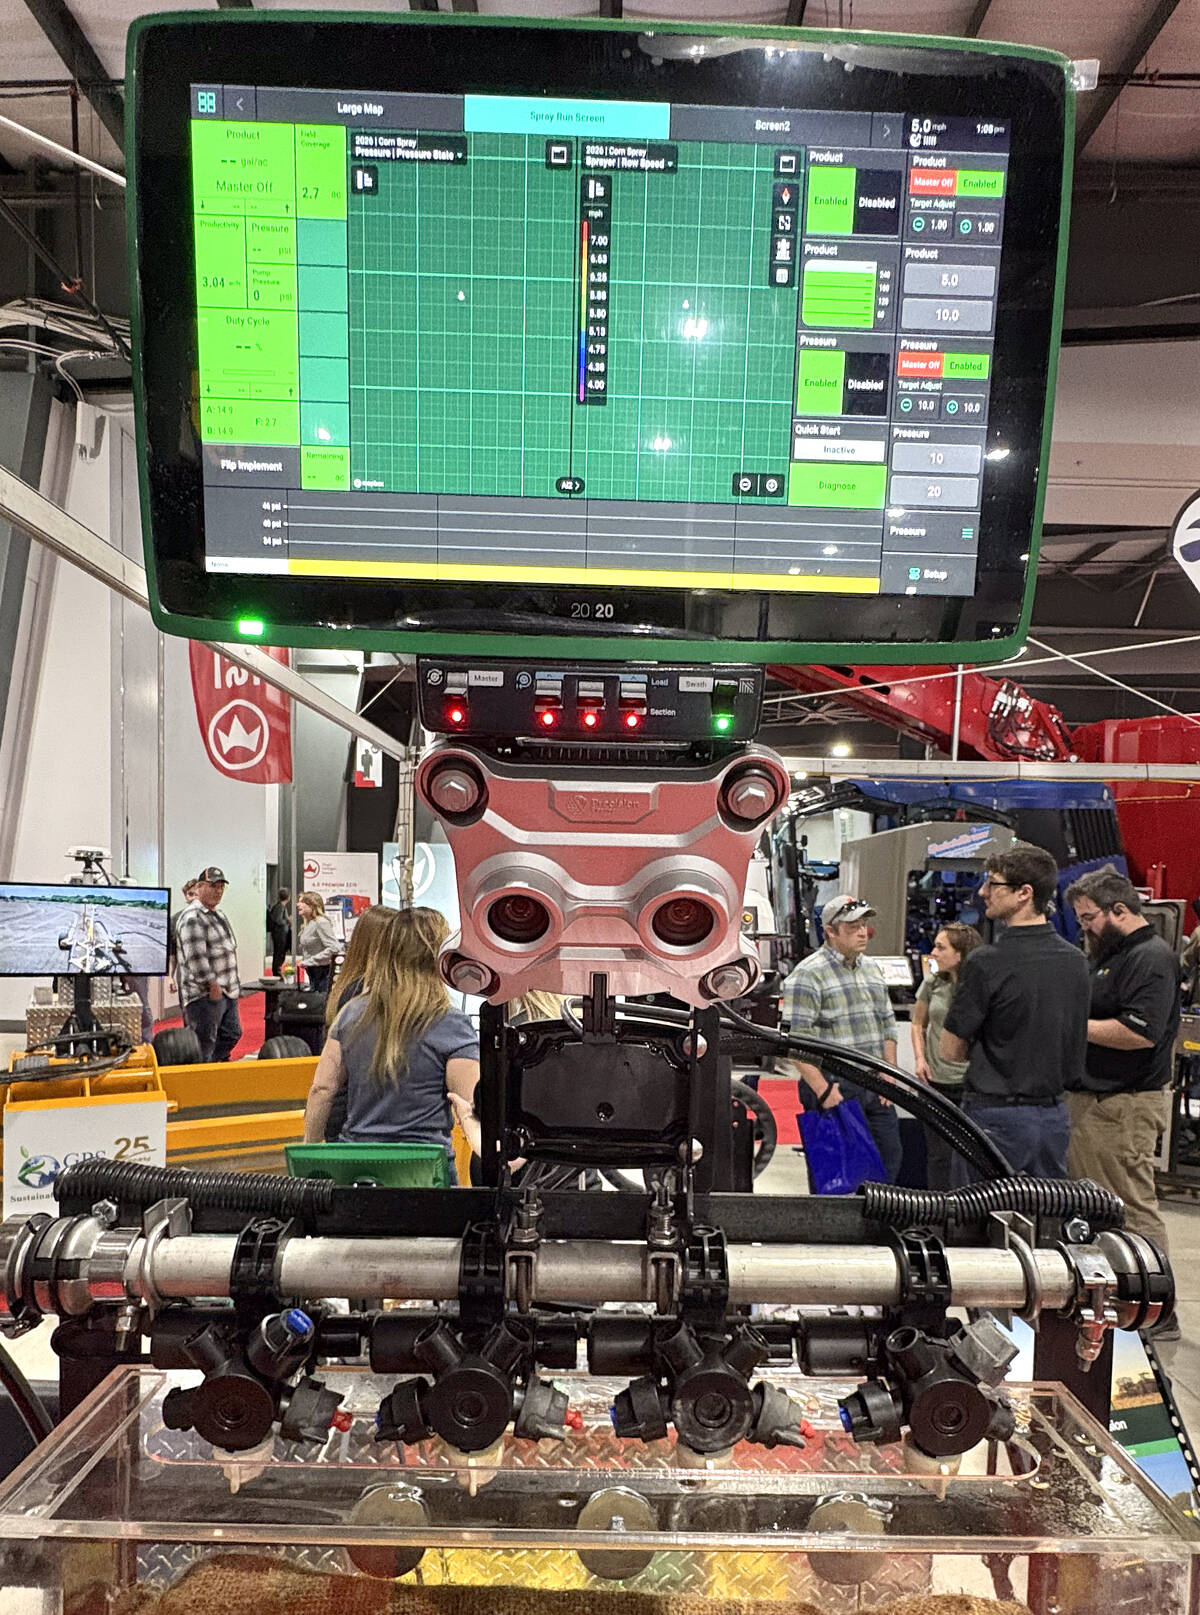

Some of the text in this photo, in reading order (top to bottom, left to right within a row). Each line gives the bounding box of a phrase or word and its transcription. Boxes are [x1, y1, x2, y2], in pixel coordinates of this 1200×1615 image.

[337, 102, 383, 116] Large Map
[530, 111, 605, 123] Spray Run Screen
[755, 119, 791, 132] Screen2
[932, 123, 947, 132] mph
[226, 129, 260, 140] Product
[301, 130, 316, 138] Field
[301, 141, 330, 150] Coverage
[378, 136, 396, 146] Corn
[396, 137, 416, 149] Spray
[355, 146, 454, 161] Pressure Pressure State
[609, 147, 626, 156] Corn
[626, 147, 647, 158] Spray
[809, 151, 843, 163] Product
[240, 157, 268, 168] gal/ac
[585, 156, 665, 171] Sprayer Row Speed
[912, 156, 946, 167] Product
[216, 180, 273, 193] Master Off
[914, 178, 953, 187] Master Off
[964, 179, 997, 189] Enabled
[302, 187, 319, 200] 2.7
[814, 196, 848, 206] Enabled
[858, 197, 896, 209] Disabled
[910, 198, 956, 210] Target Adjust
[588, 210, 603, 219] mph
[200, 220, 239, 230] Productivity
[251, 223, 289, 233] Pressure
[931, 219, 947, 230] 1.00
[977, 222, 995, 232] 1.00
[591, 235, 608, 246] 7.00
[804, 245, 838, 256] Product
[905, 248, 938, 259] Product
[202, 276, 224, 288] 3.04
[253, 289, 260, 301] 0
[936, 308, 959, 321] 10.0
[225, 315, 270, 327] Duty Cycle
[800, 336, 837, 347] Pressure
[901, 340, 938, 351] Pressure
[902, 360, 940, 370] Master Off
[950, 361, 983, 371] Enabled
[587, 380, 605, 390] 4.00
[804, 378, 837, 388] Enabled
[847, 379, 884, 391] Disabled
[898, 381, 942, 392] Target Adjust
[918, 400, 935, 411] 10.0
[964, 402, 980, 413] 10.0
[795, 425, 841, 436] Quick Start
[893, 428, 930, 439] Pressure
[306, 452, 344, 460] Remaining
[823, 446, 856, 455] Inactive
[930, 453, 944, 464] 10
[221, 459, 283, 472] Flip Implement
[818, 481, 856, 492] Diagnose
[927, 486, 941, 497] 20
[889, 527, 926, 537] Pressure
[923, 569, 948, 581] Setup
[570, 602, 614, 619] 20 20
[474, 674, 498, 682] Master
[651, 677, 669, 686] Load
[650, 708, 676, 717] Section
[114, 1136, 149, 1160] 25
